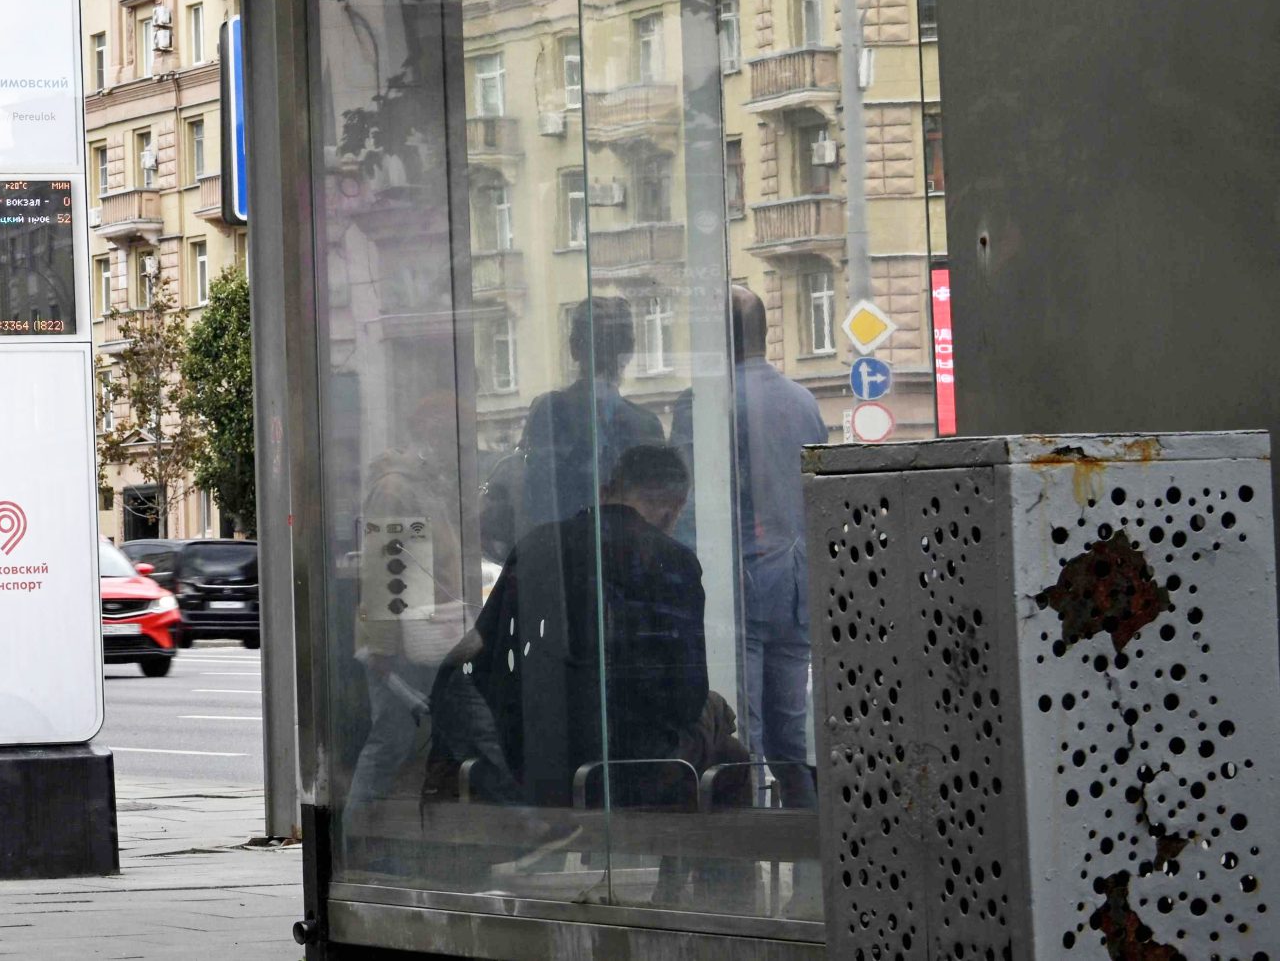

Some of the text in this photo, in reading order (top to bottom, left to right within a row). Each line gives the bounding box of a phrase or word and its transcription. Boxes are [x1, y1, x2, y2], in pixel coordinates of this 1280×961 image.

[12, 111, 56, 121] Pereulok
[51, 182, 70, 190] МИН
[6, 198, 41, 207] вокзал
[57, 213, 71, 223] 52
[34, 320, 64, 331] (1822)
